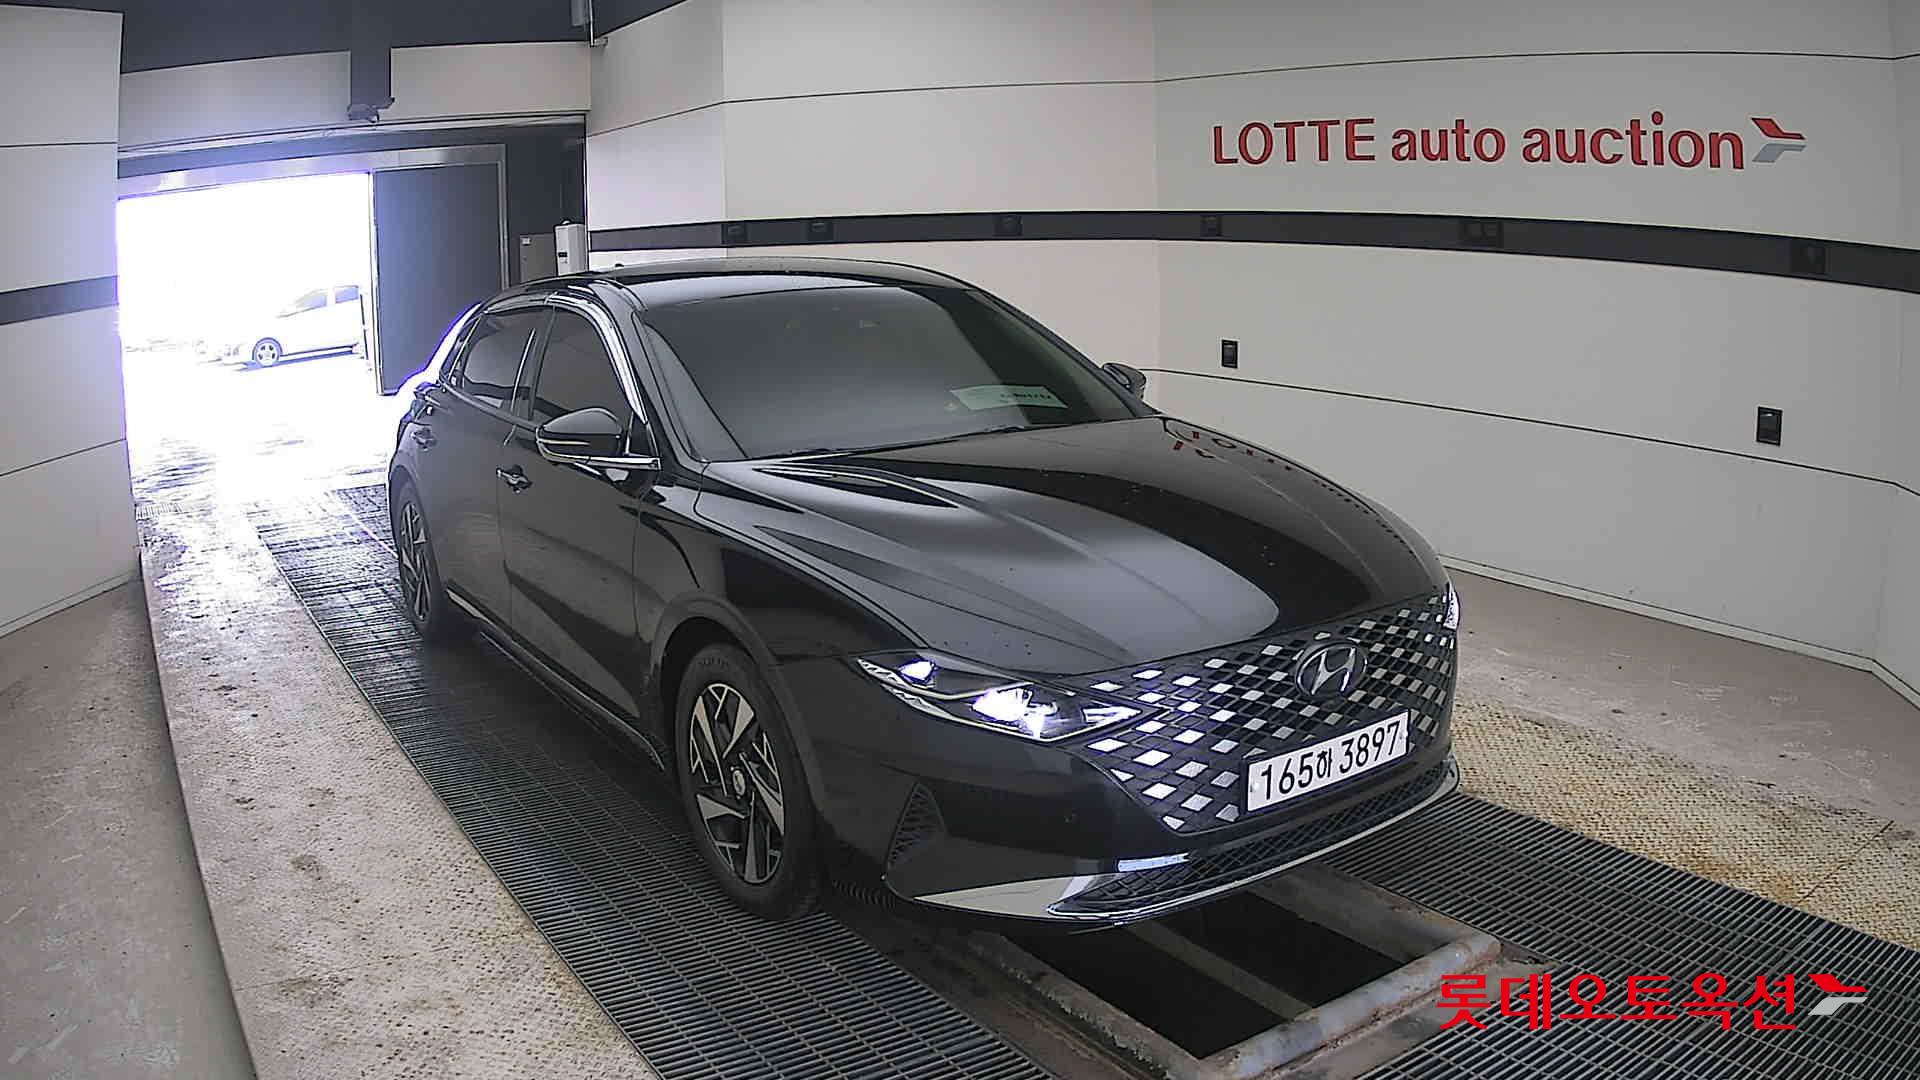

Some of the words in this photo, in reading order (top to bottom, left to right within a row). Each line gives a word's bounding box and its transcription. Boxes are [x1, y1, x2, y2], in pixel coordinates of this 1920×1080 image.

[1213, 118, 1376, 165] LOTTE
[1391, 119, 1508, 163] auto
[1522, 111, 1745, 171] auction
[1260, 747, 1333, 800] 165하
[1339, 719, 1401, 774] 3897
